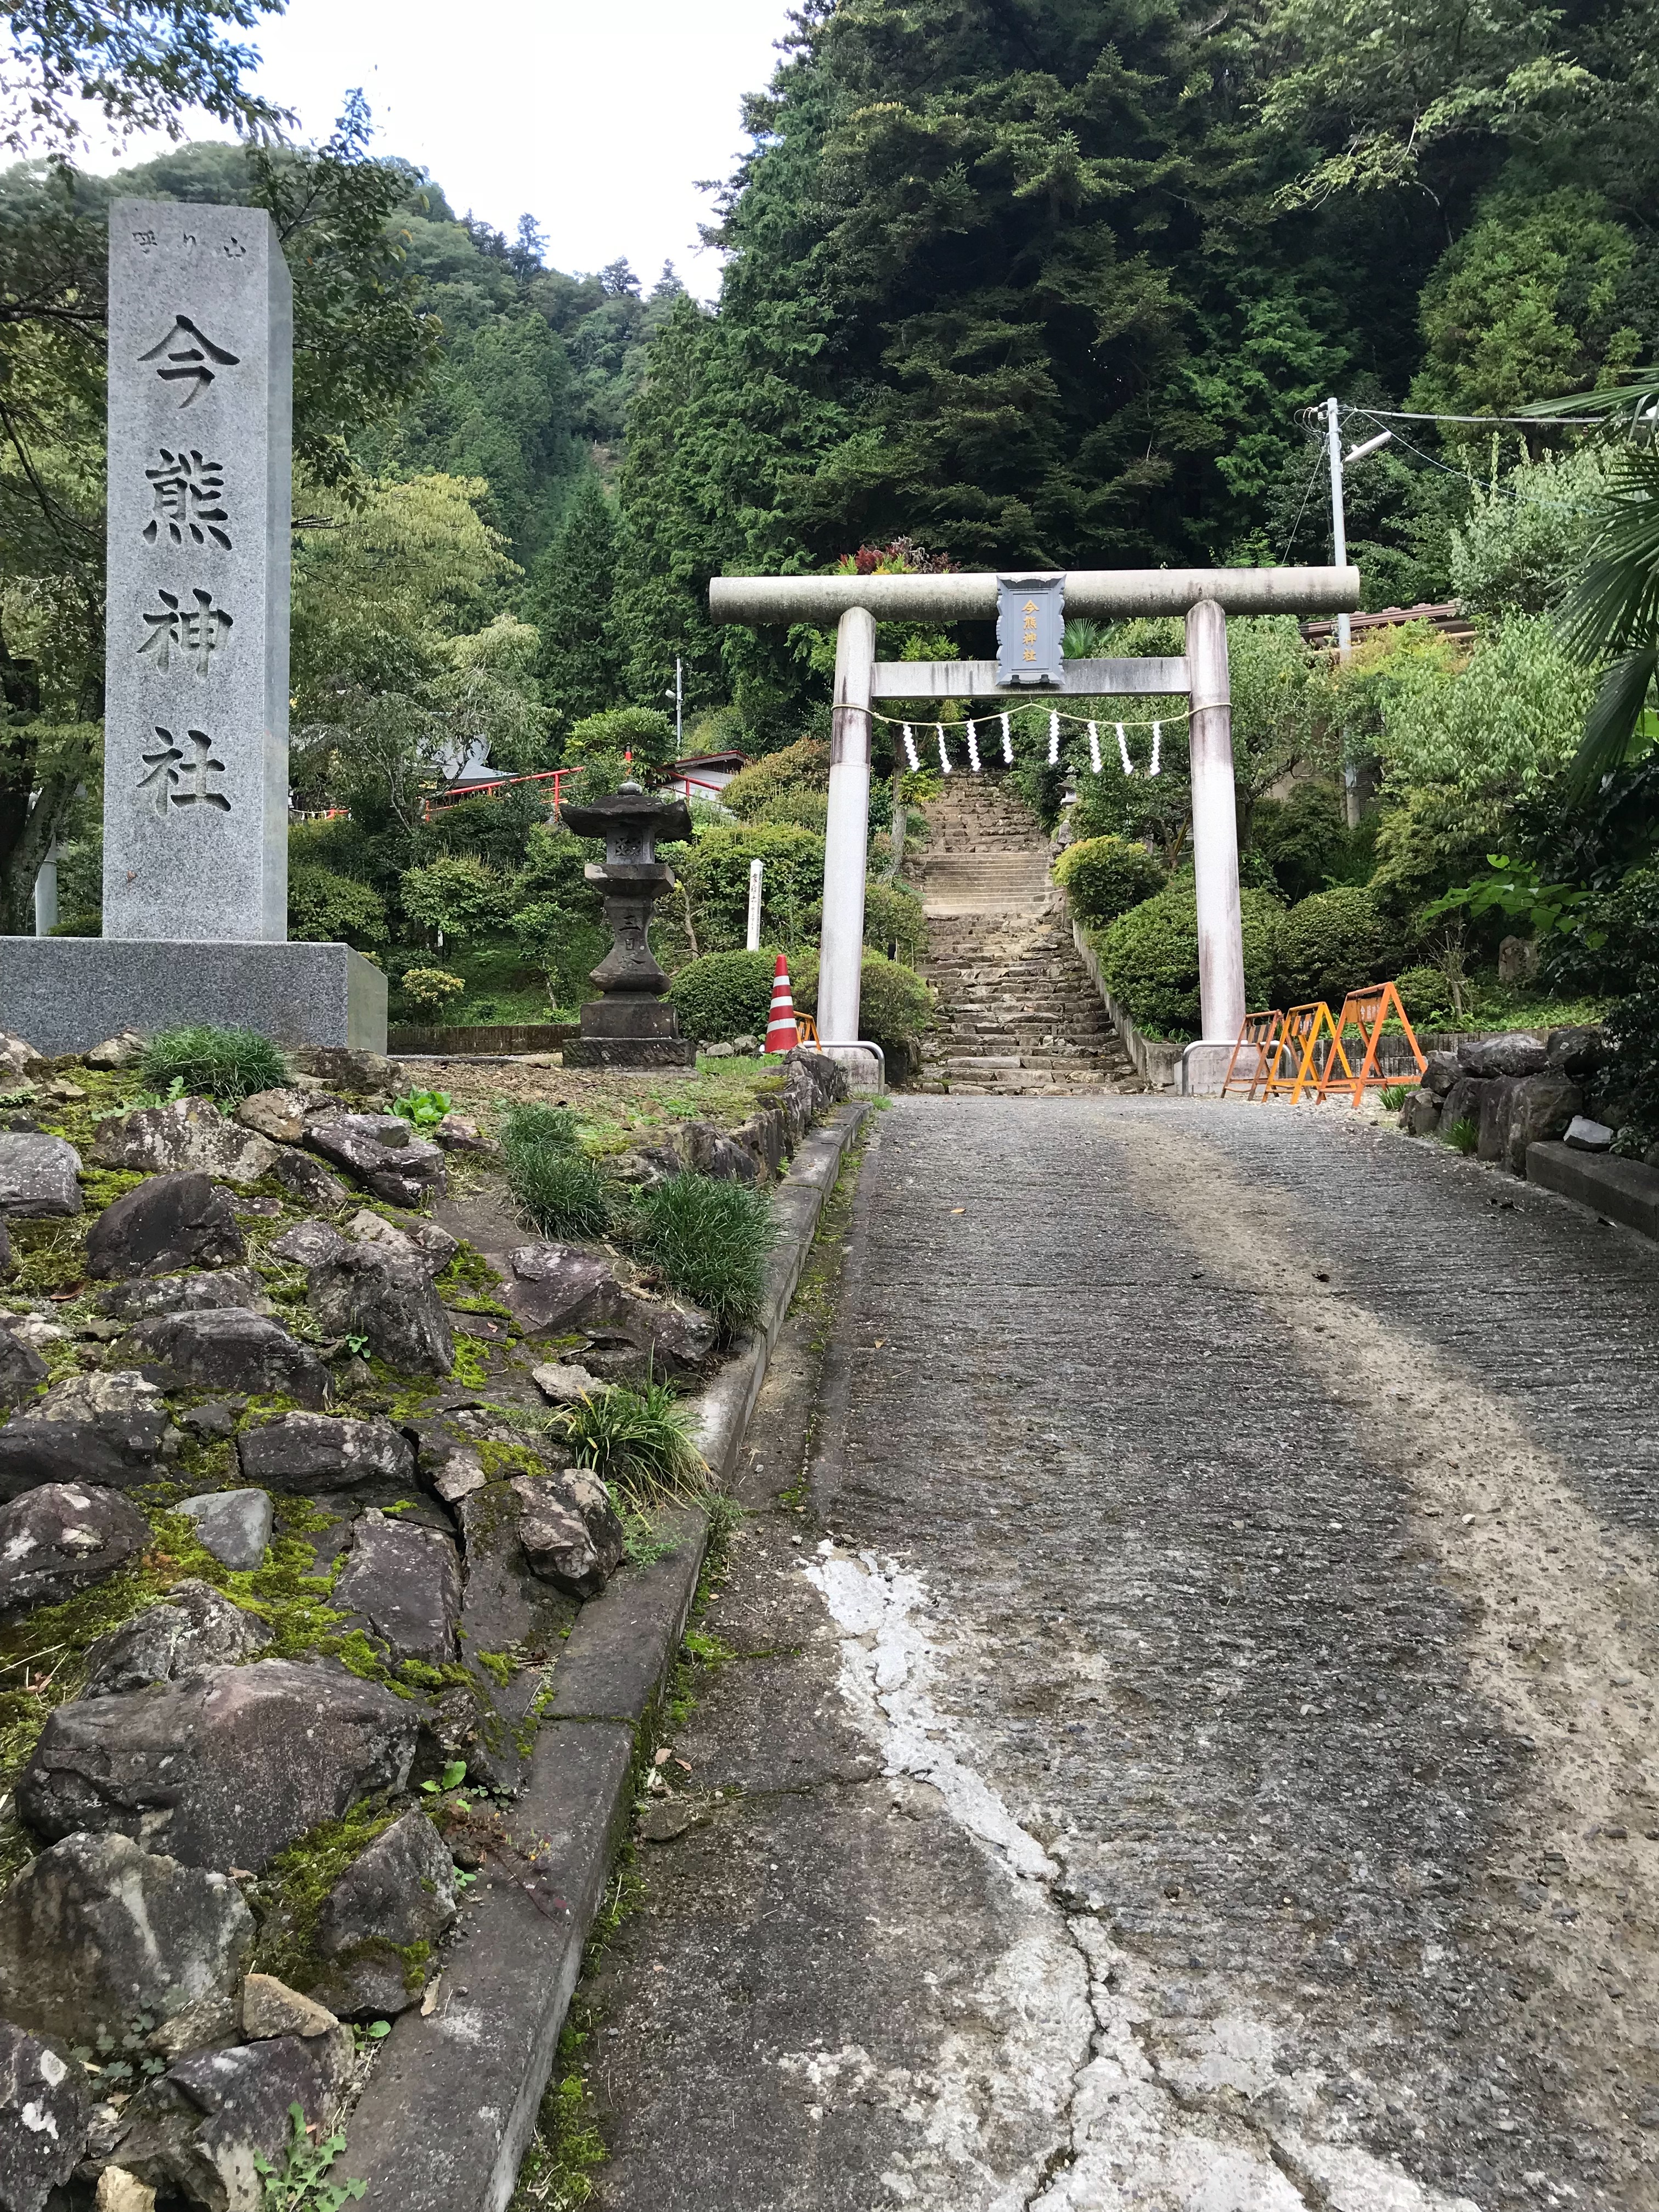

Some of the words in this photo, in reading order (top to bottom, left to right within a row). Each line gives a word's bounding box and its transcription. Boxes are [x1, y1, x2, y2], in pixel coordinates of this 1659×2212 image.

[136, 314, 241, 817] 今熊神社
[1021, 599, 1040, 662] 今熊神社
